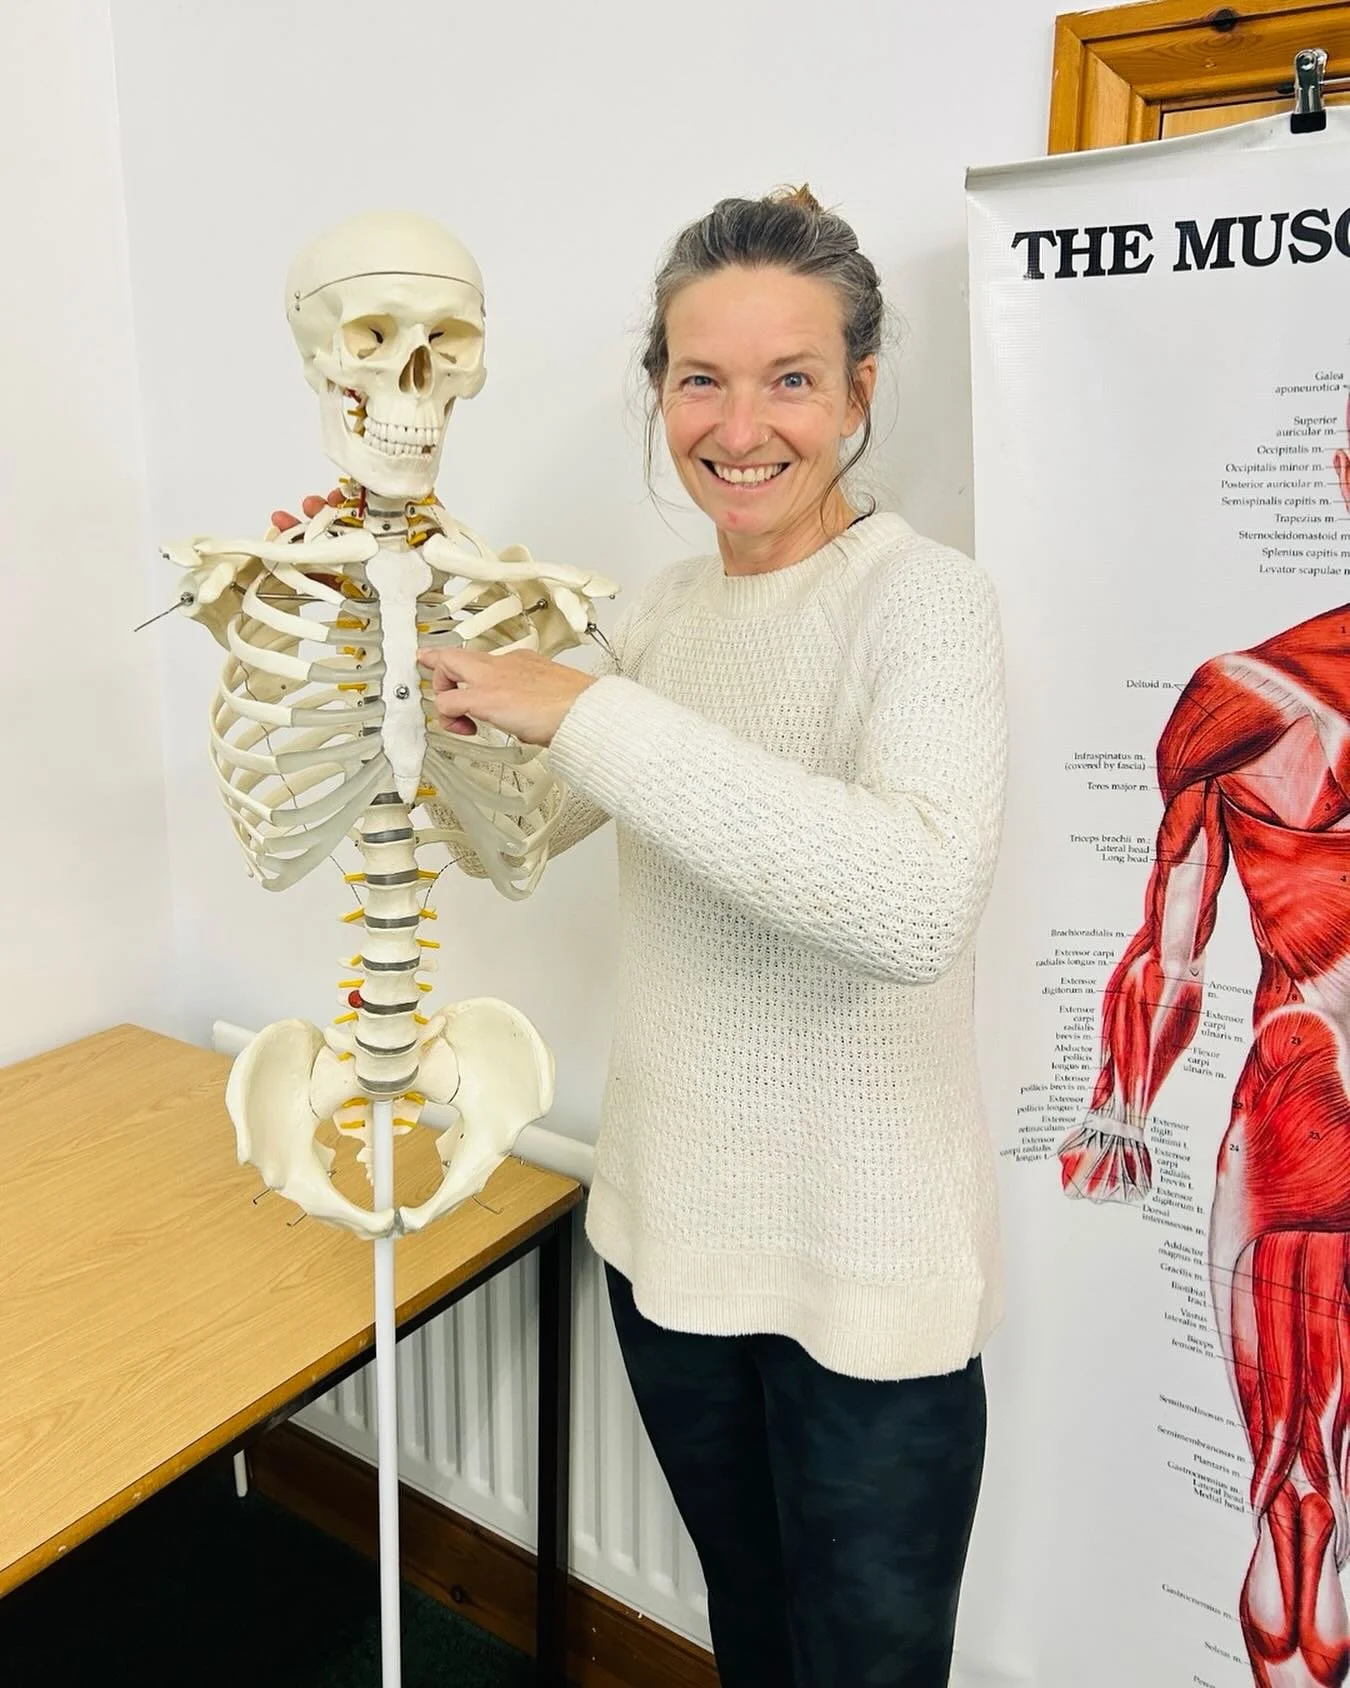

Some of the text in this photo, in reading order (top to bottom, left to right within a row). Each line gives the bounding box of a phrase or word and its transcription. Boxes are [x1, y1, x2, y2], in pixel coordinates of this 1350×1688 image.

[1011, 224, 1154, 280] THE
[1315, 371, 1344, 381] Galea
[1275, 384, 1340, 396] aponeurotica
[1294, 416, 1338, 426] Superior
[1276, 427, 1322, 437] auricular
[1257, 445, 1309, 457] Occipitalis
[1226, 464, 1276, 474] Occipitalis
[1221, 480, 1264, 488] Posterior
[1267, 480, 1311, 488] auricular
[1221, 497, 1281, 508] Semispinalis
[1284, 498, 1316, 508] capitis
[1275, 514, 1322, 525] Trapezius
[1239, 530, 1337, 540] Sternocleidomastoid
[1262, 547, 1303, 558] Splenius
[1306, 550, 1338, 559] capitis
[1260, 564, 1296, 574] Levator
[1299, 566, 1341, 576] scapulae
[1127, 680, 1159, 688] Deltoid
[1074, 752, 1131, 762] Infraspinatus
[1065, 761, 1146, 771] (covered by fascia)
[1088, 782, 1109, 790] Teres
[1112, 784, 1137, 792] major
[1071, 834, 1099, 844] Triceps
[1102, 835, 1131, 843] brachii
[1096, 844, 1150, 854] Lateral head
[1102, 854, 1148, 863] Long head
